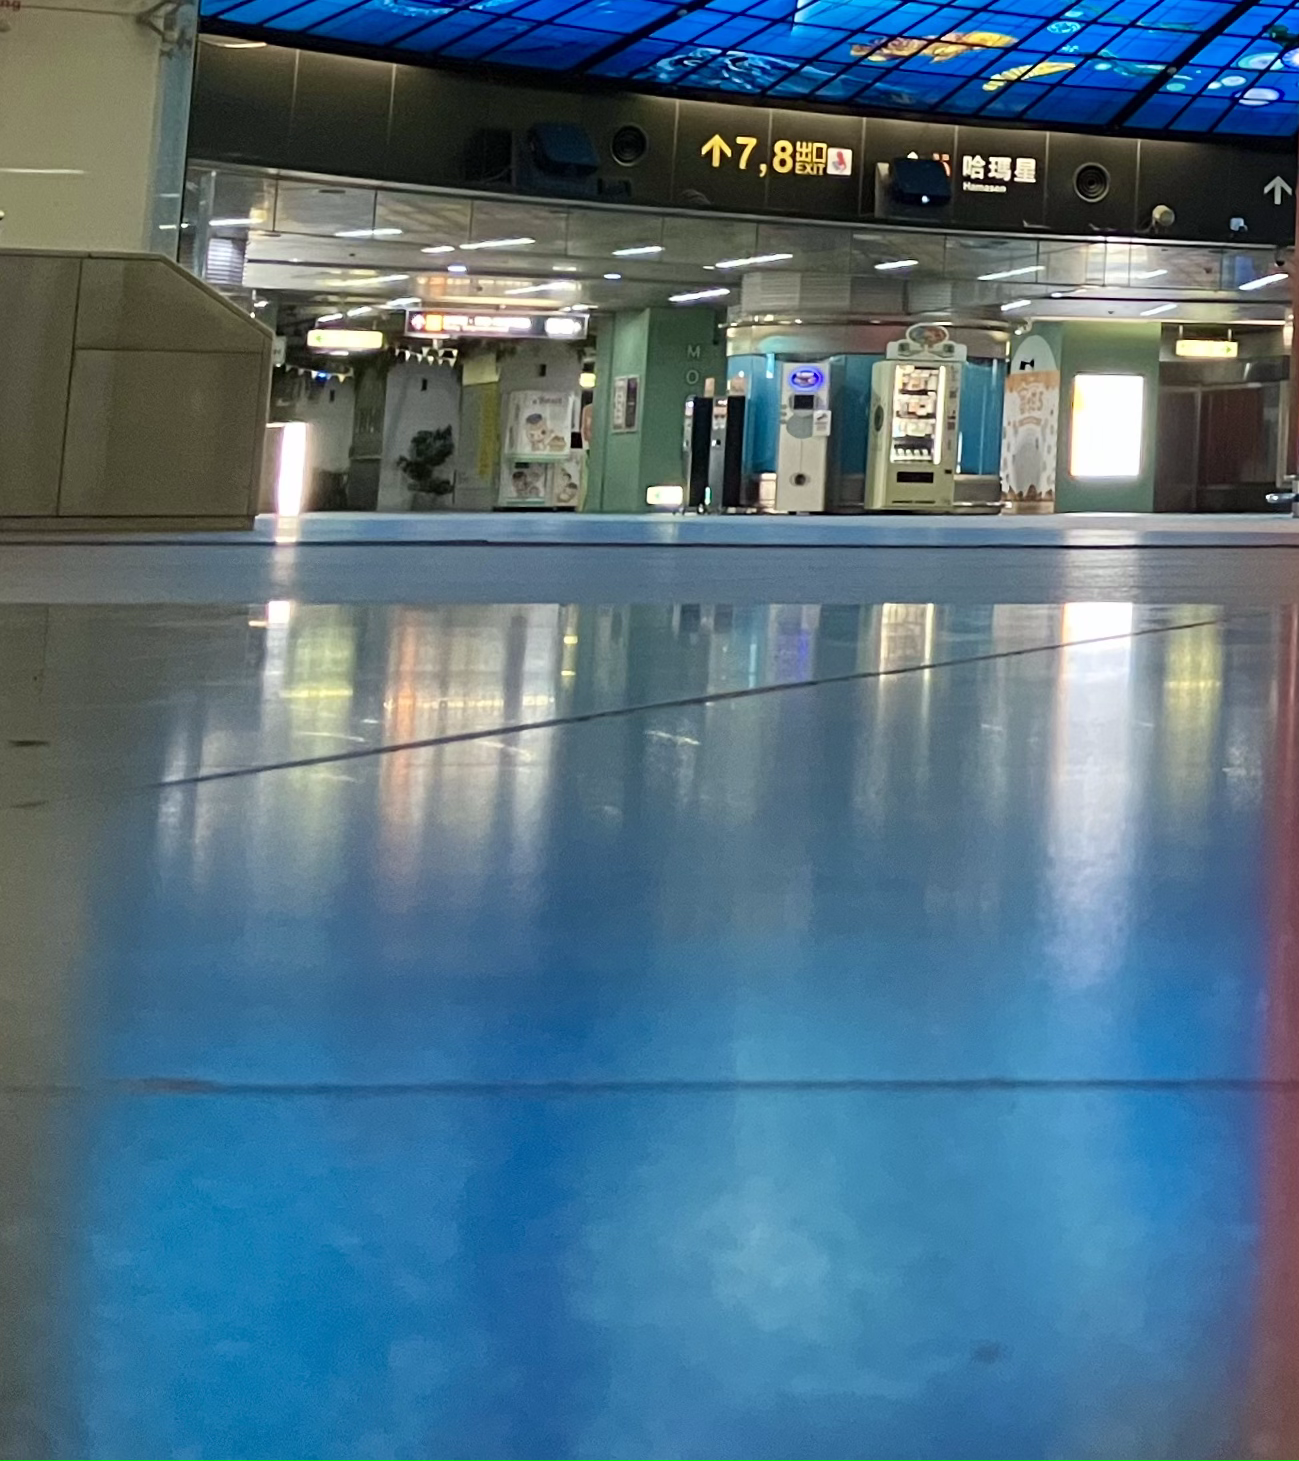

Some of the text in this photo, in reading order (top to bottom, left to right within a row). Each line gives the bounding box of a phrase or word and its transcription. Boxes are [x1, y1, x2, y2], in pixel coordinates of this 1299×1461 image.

[796, 141, 828, 164] 出口
[795, 162, 826, 176] EXIT
[962, 154, 1037, 183] 哈瑪星
